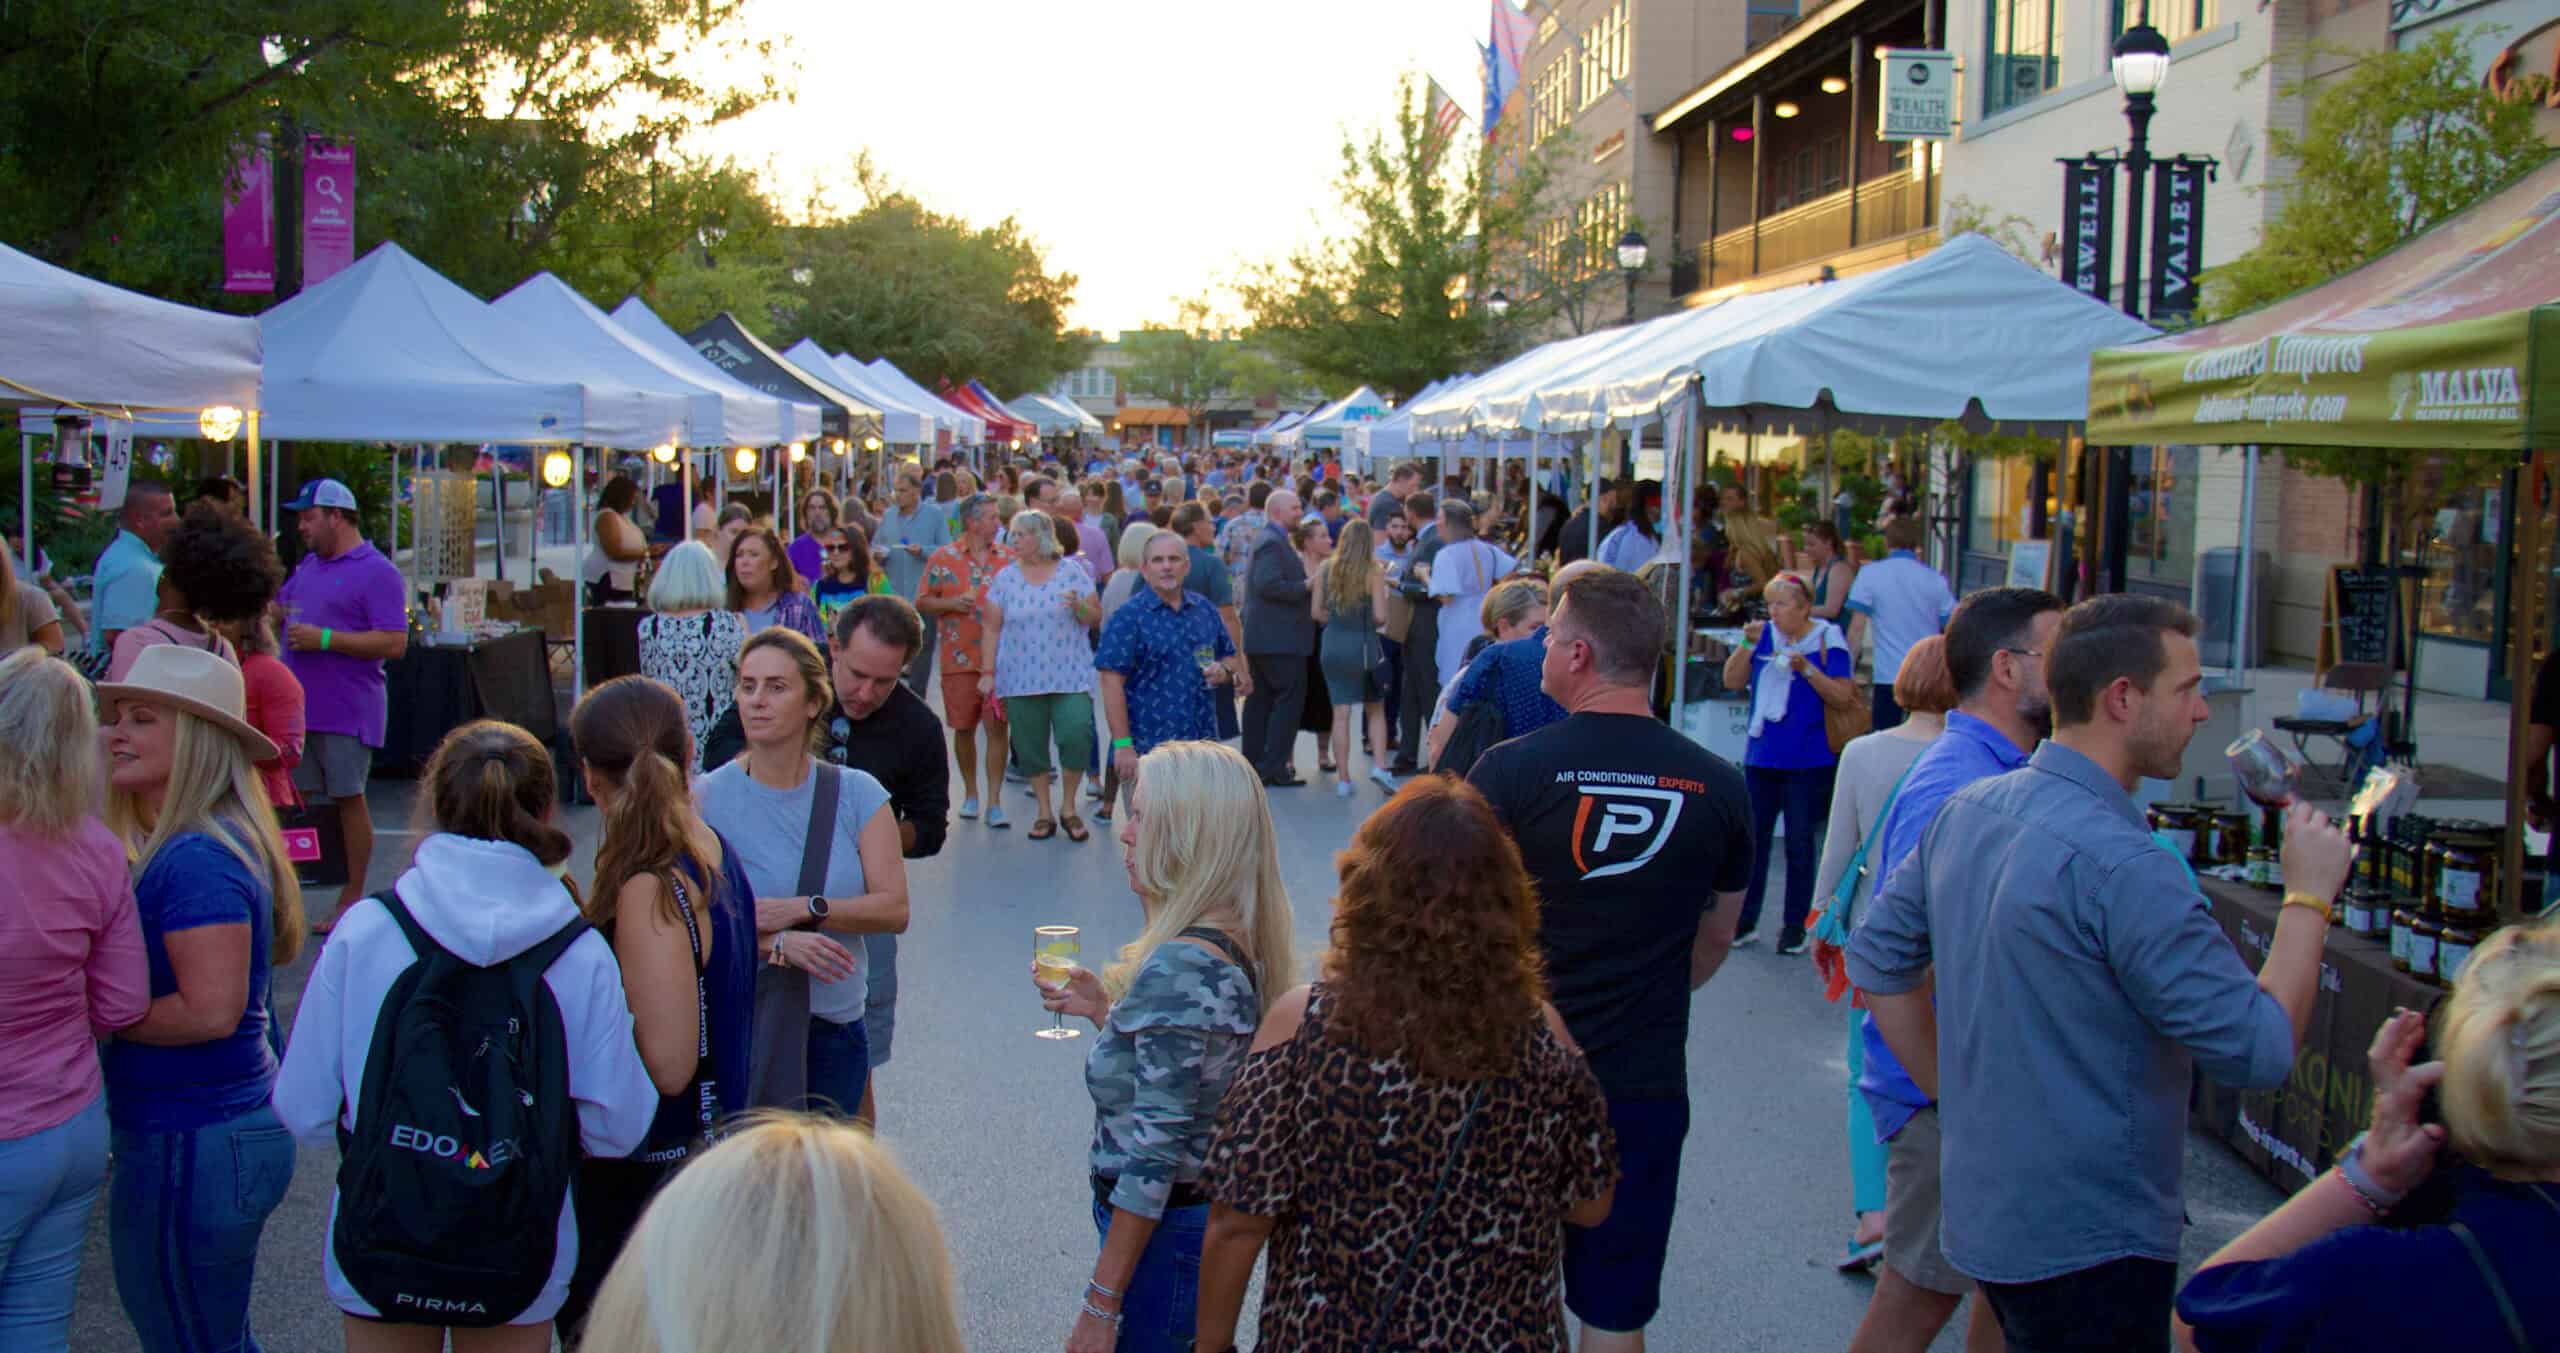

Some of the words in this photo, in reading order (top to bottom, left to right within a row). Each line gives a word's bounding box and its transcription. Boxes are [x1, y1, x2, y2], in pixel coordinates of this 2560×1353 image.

[1887, 113, 1946, 130] BUILDERS
[1889, 97, 1945, 113] WEALTH
[2077, 176, 2100, 291] EWELL
[2164, 173, 2192, 298] VALET
[2273, 335, 2372, 384] Imports
[2419, 367, 2520, 405] MALVA
[1555, 770, 1575, 783] AIR
[1577, 771, 1656, 786] CONDITIONING
[1658, 776, 1705, 794] EXPERTS
[1593, 803, 1654, 852] P
[391, 1124, 524, 1170] EDOMEX
[396, 1292, 487, 1313] PIRMA
